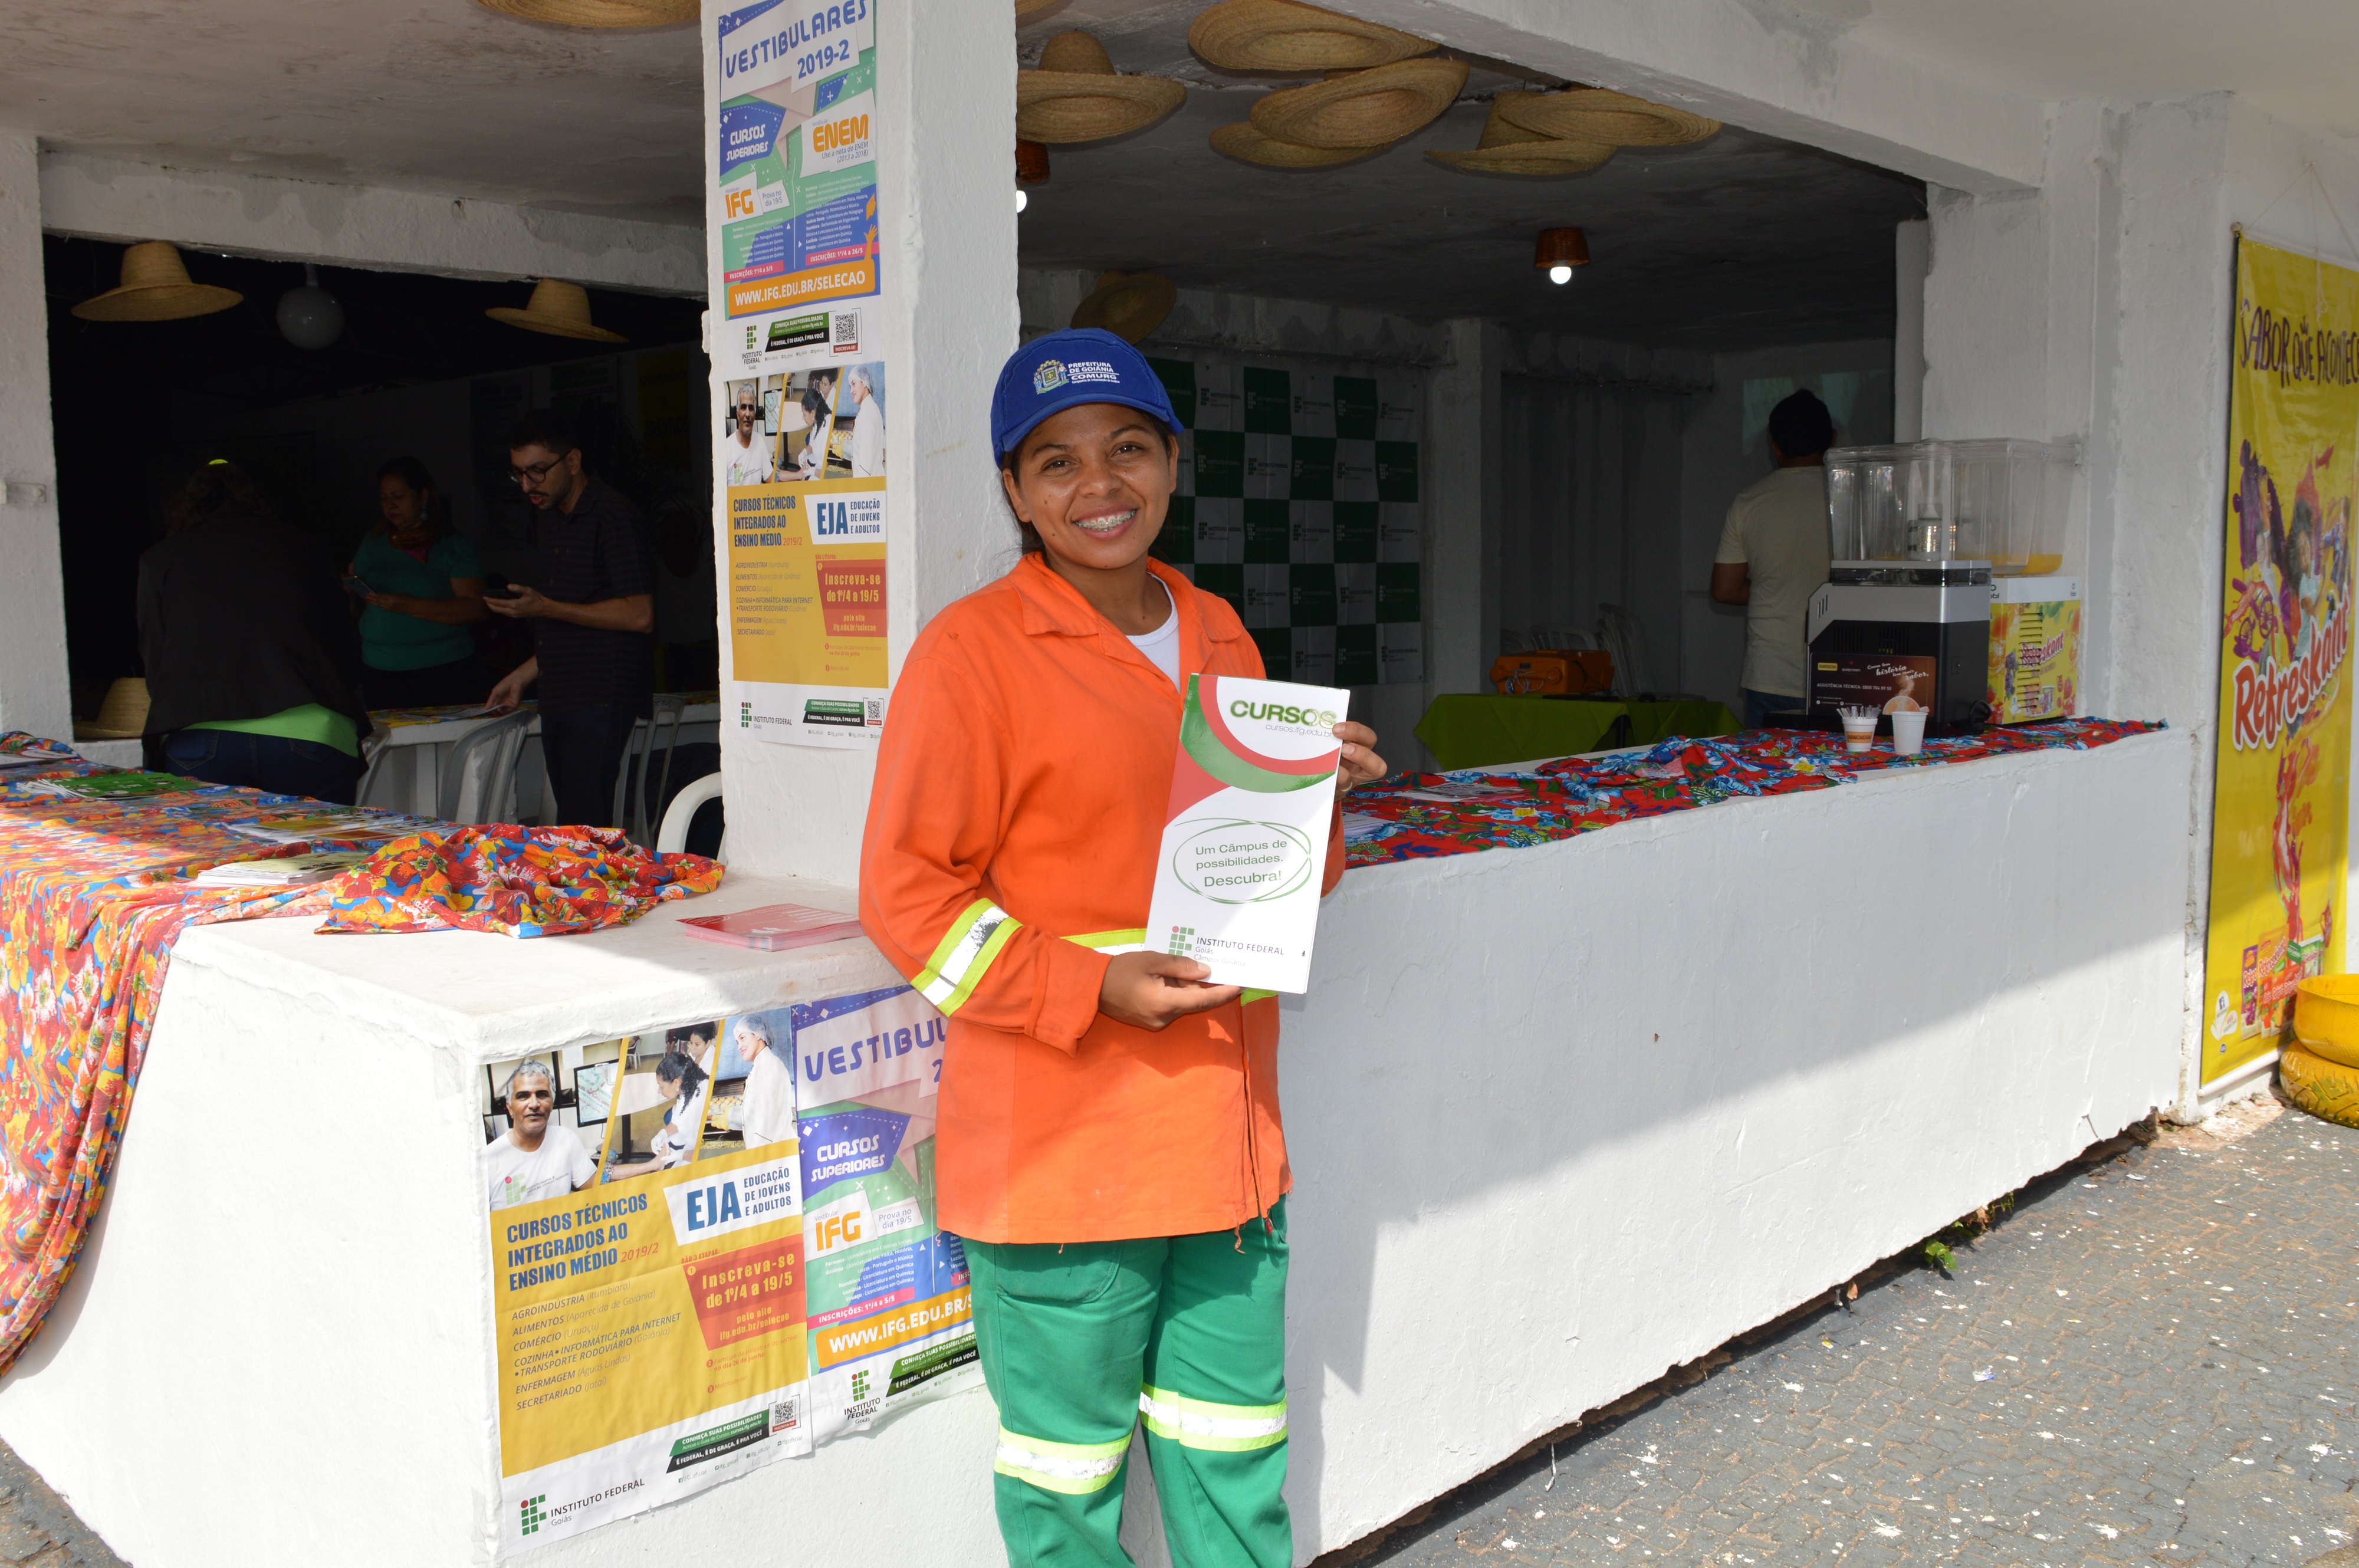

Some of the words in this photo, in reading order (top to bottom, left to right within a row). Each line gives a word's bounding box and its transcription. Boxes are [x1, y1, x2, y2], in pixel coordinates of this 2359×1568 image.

[726, 0, 866, 78] VESTIBULARES
[797, 39, 850, 79] 2019-2
[730, 124, 765, 145] CURSOS
[813, 114, 869, 152] ENEM
[726, 142, 768, 161] SUPERIORES
[836, 147, 847, 155] nota
[855, 140, 868, 151] ENEM
[837, 153, 851, 163] (2013
[855, 150, 868, 161] 2018)
[725, 189, 754, 219] IFG
[773, 196, 783, 205] 19/5
[810, 252, 836, 262] INSCRIÇÕES:
[735, 271, 865, 306] WWW.IFG.EDU.BR/SELECAO
[2240, 298, 2290, 389] SABOR
[742, 350, 762, 359] INSTITUTO
[734, 498, 761, 512] CURSOS
[763, 494, 796, 510] TÉCNICOS
[850, 498, 880, 511] EDUCAÇÃO
[734, 516, 776, 530] INTEGRADOS
[777, 515, 786, 528] AO
[817, 502, 849, 535] EJA
[859, 512, 880, 521] JOVENS
[734, 534, 758, 547] ENSINO
[760, 530, 781, 546] MÉDIO
[783, 537, 802, 545] 2019/2
[850, 525, 853, 534] E
[855, 525, 880, 534] ADULTOS
[825, 573, 880, 585] Inscreva-se
[1876, 665, 1907, 676] história
[2234, 585, 2350, 748] Refreskant
[1230, 699, 1337, 729] CURSOS
[1265, 724, 1333, 738] cursos.ifg.edu.br
[1195, 846, 1215, 856] Um
[1218, 841, 1269, 856] Câmpus
[1272, 839, 1287, 849] de
[1195, 853, 1283, 871] possibilidades.
[1204, 870, 1282, 887] Descubra!
[1195, 945, 1214, 955] Goiás
[1197, 937, 1244, 950] INSTITUTO
[1246, 943, 1284, 955] FEDERAL
[804, 1017, 946, 1082] VESTIBUL
[817, 1134, 880, 1162] CURSOS
[744, 1166, 789, 1188] EDUCAÇÃO
[811, 1154, 885, 1182] SUPERIORES
[745, 1192, 755, 1202] DE
[758, 1182, 790, 1199] JOVENS
[687, 1181, 742, 1231] EJA
[745, 1207, 750, 1217] E
[753, 1196, 791, 1215] ADULTOS
[814, 1209, 839, 1221] Vestibular
[879, 1211, 900, 1222] Prova
[507, 1212, 572, 1243] CURSOS
[575, 1193, 648, 1227] TÉCNICOS
[882, 1221, 893, 1230] dia
[895, 1215, 912, 1227] 19/5
[816, 1211, 861, 1251] IFG
[508, 1228, 604, 1268] INTEGRADOS
[608, 1222, 628, 1242] AO
[510, 1261, 566, 1291] ENSINO
[570, 1248, 617, 1276] MÉDIO
[620, 1242, 659, 1263] 2019/2
[681, 1255, 692, 1264] SÃO
[699, 1249, 720, 1259] ETAPAS:
[702, 1253, 795, 1290] Inscreva-se
[707, 1293, 722, 1309] de
[751, 1283, 760, 1296] a
[763, 1271, 793, 1292] 19/5
[512, 1294, 584, 1321] AGROINDÚSTRIA
[587, 1281, 631, 1302] (Itumbiara)
[819, 1306, 863, 1323] INSCRIÇÕES:
[885, 1296, 895, 1304] 5/5
[512, 1315, 564, 1336] ALIMENTOS
[566, 1305, 609, 1323] (Aparecida
[611, 1300, 620, 1309] de
[623, 1290, 656, 1306] Goiânia)
[737, 1312, 754, 1324] pelo
[757, 1307, 772, 1317] site
[514, 1332, 561, 1352] COMÉRCIO
[564, 1322, 599, 1340] (Uruaçu)
[720, 1313, 790, 1340] ifg.edu.br/selecao
[514, 1350, 554, 1368] COZINHA
[561, 1331, 618, 1355] INFORMÁTICA
[620, 1324, 640, 1337] PARA
[642, 1312, 681, 1330] INTERNET
[520, 1354, 577, 1377] TRANSPORTE
[580, 1337, 632, 1360] RODOVIÁRIO
[634, 1327, 671, 1345] (Goiânia)
[516, 1370, 576, 1394] ENFERMAGEM
[577, 1364, 603, 1378] (Águas
[604, 1354, 630, 1369] Lindas)
[517, 1385, 582, 1411] SECRETARIADO
[584, 1376, 607, 1392] (Jataí)
[844, 1397, 880, 1416] INSTITUTO
[847, 1406, 878, 1420] FEDERAL
[682, 1432, 708, 1445] CONHEÇA
[709, 1426, 722, 1436] SUAS
[723, 1413, 762, 1432] POSSIBILIDADES
[855, 1416, 870, 1425] Goiás
[681, 1452, 704, 1464] FEDERAL,
[717, 1442, 736, 1452] GRAÇA,
[740, 1435, 750, 1444] PRA
[750, 1429, 763, 1440] VOCÊ
[551, 1494, 602, 1517] INSTITUTO
[604, 1478, 645, 1498] FEDERAL
[551, 1515, 572, 1526] Goiás
